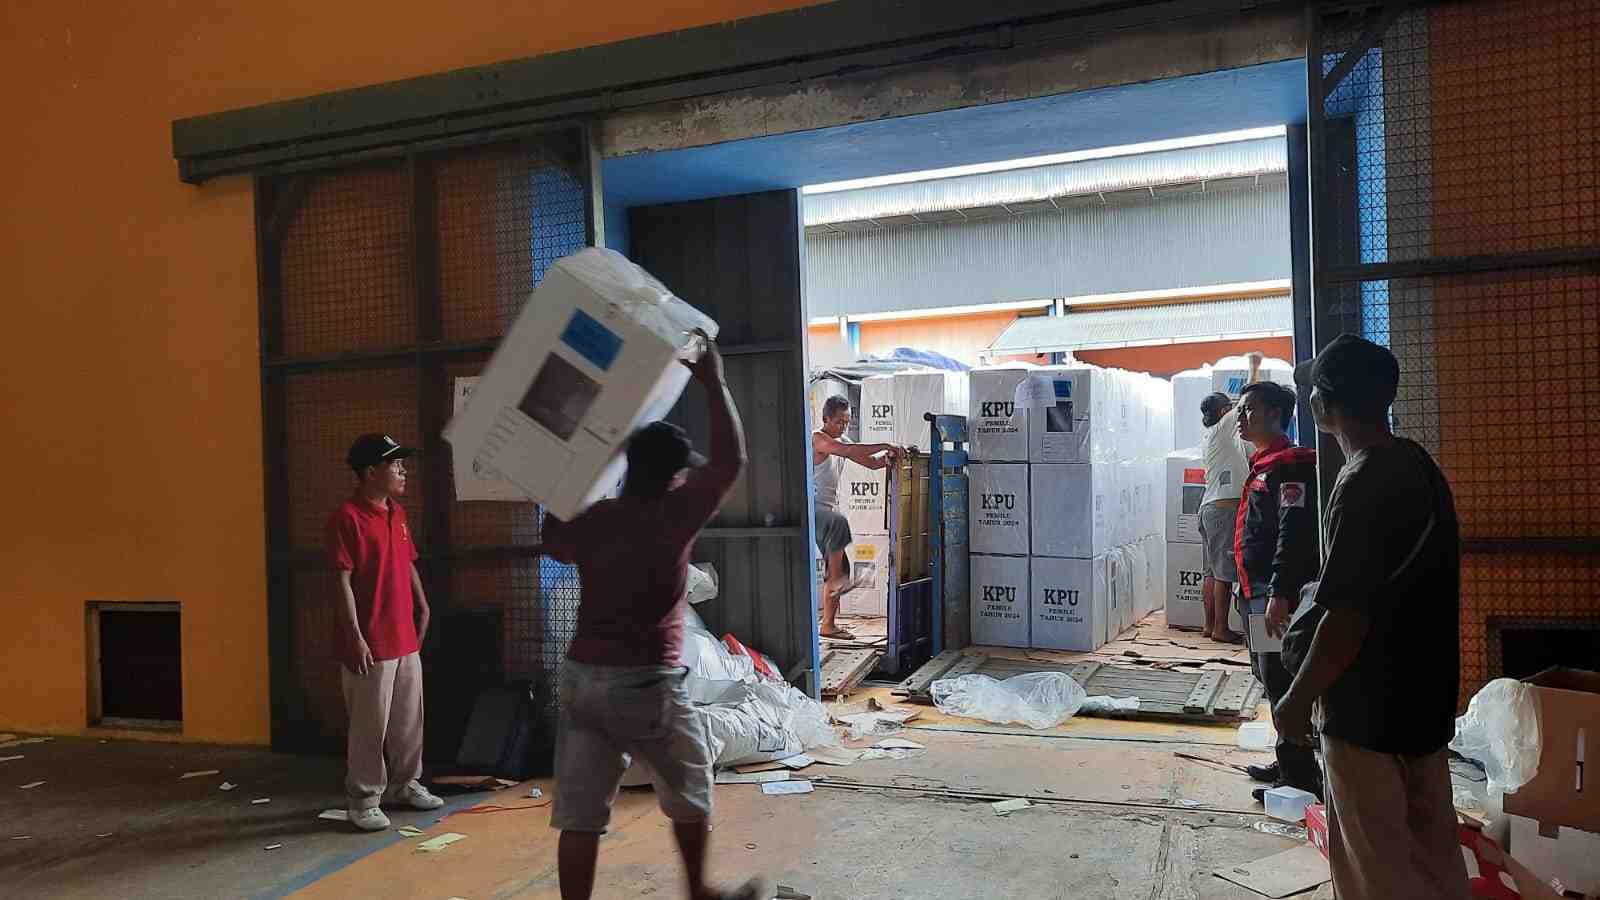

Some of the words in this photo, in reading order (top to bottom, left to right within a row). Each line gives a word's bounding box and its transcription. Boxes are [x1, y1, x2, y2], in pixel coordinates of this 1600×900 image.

[981, 401, 1015, 418] KPU
[850, 481, 880, 496] KPU
[981, 493, 1016, 510] KPU
[1179, 570, 1203, 587] KP
[982, 585, 1017, 602] KPU
[1043, 588, 1080, 606] KPU
